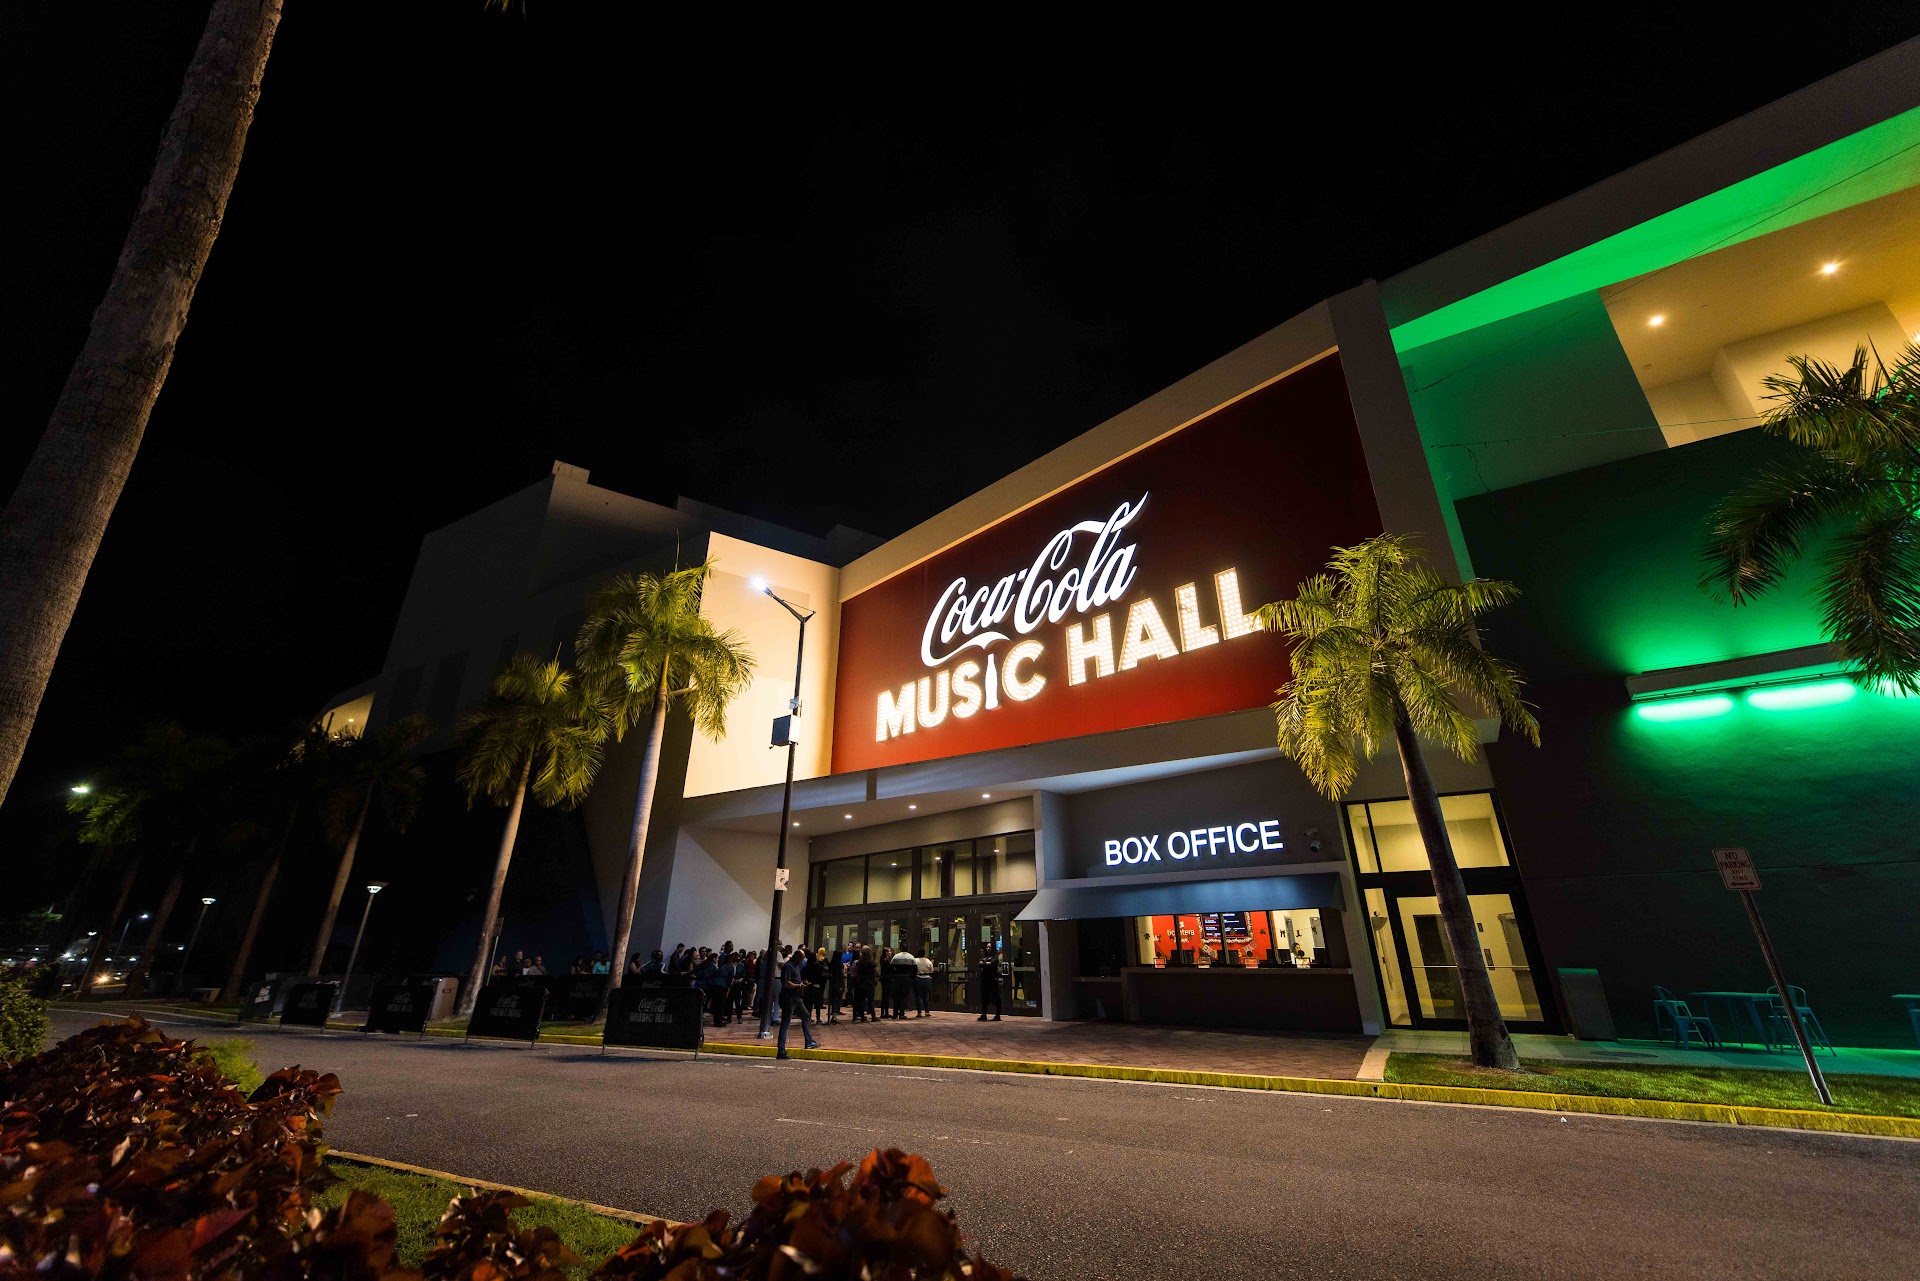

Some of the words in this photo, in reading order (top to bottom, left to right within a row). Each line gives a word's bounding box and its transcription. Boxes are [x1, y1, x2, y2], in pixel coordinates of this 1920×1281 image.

[920, 490, 1149, 667] Coca-Cola
[875, 639, 1047, 743] MUSIC
[1066, 566, 1264, 686] HALL
[1104, 834, 1161, 866] BOX
[1167, 819, 1284, 860] OFFICE
[1724, 851, 1738, 860] NO
[1720, 860, 1751, 869] PARKING
[1166, 928, 1195, 936] ticetera
[630, 1012, 654, 1023] MUSIC
[655, 1012, 673, 1024] HALL
